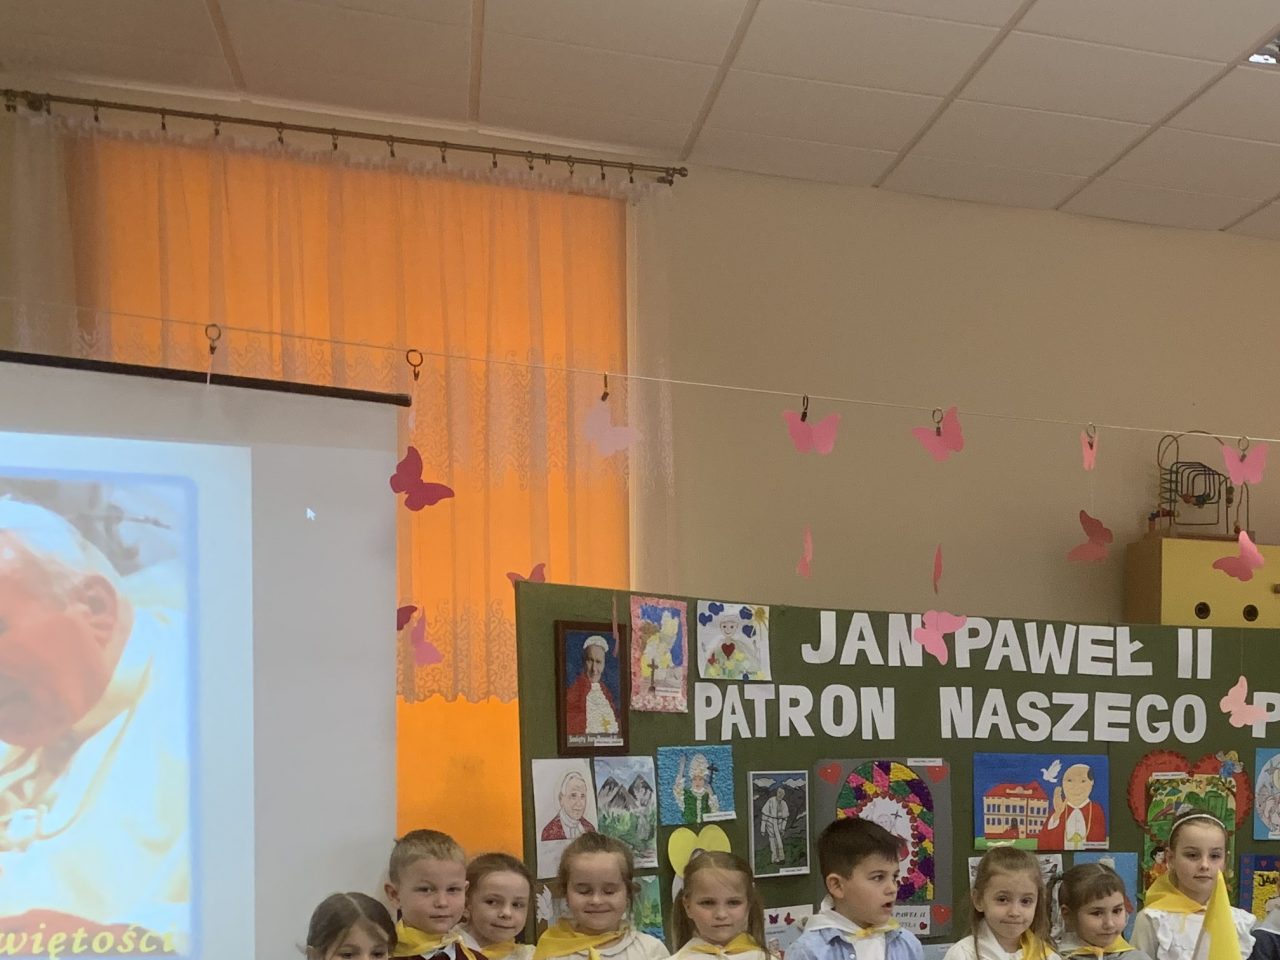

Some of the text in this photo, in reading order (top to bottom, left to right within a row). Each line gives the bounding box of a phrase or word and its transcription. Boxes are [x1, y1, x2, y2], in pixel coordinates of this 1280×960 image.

[801, 610, 1213, 680] JAN PAWEŁ II
[694, 682, 896, 741] PATRON
[939, 686, 1208, 744] NASZEGO
